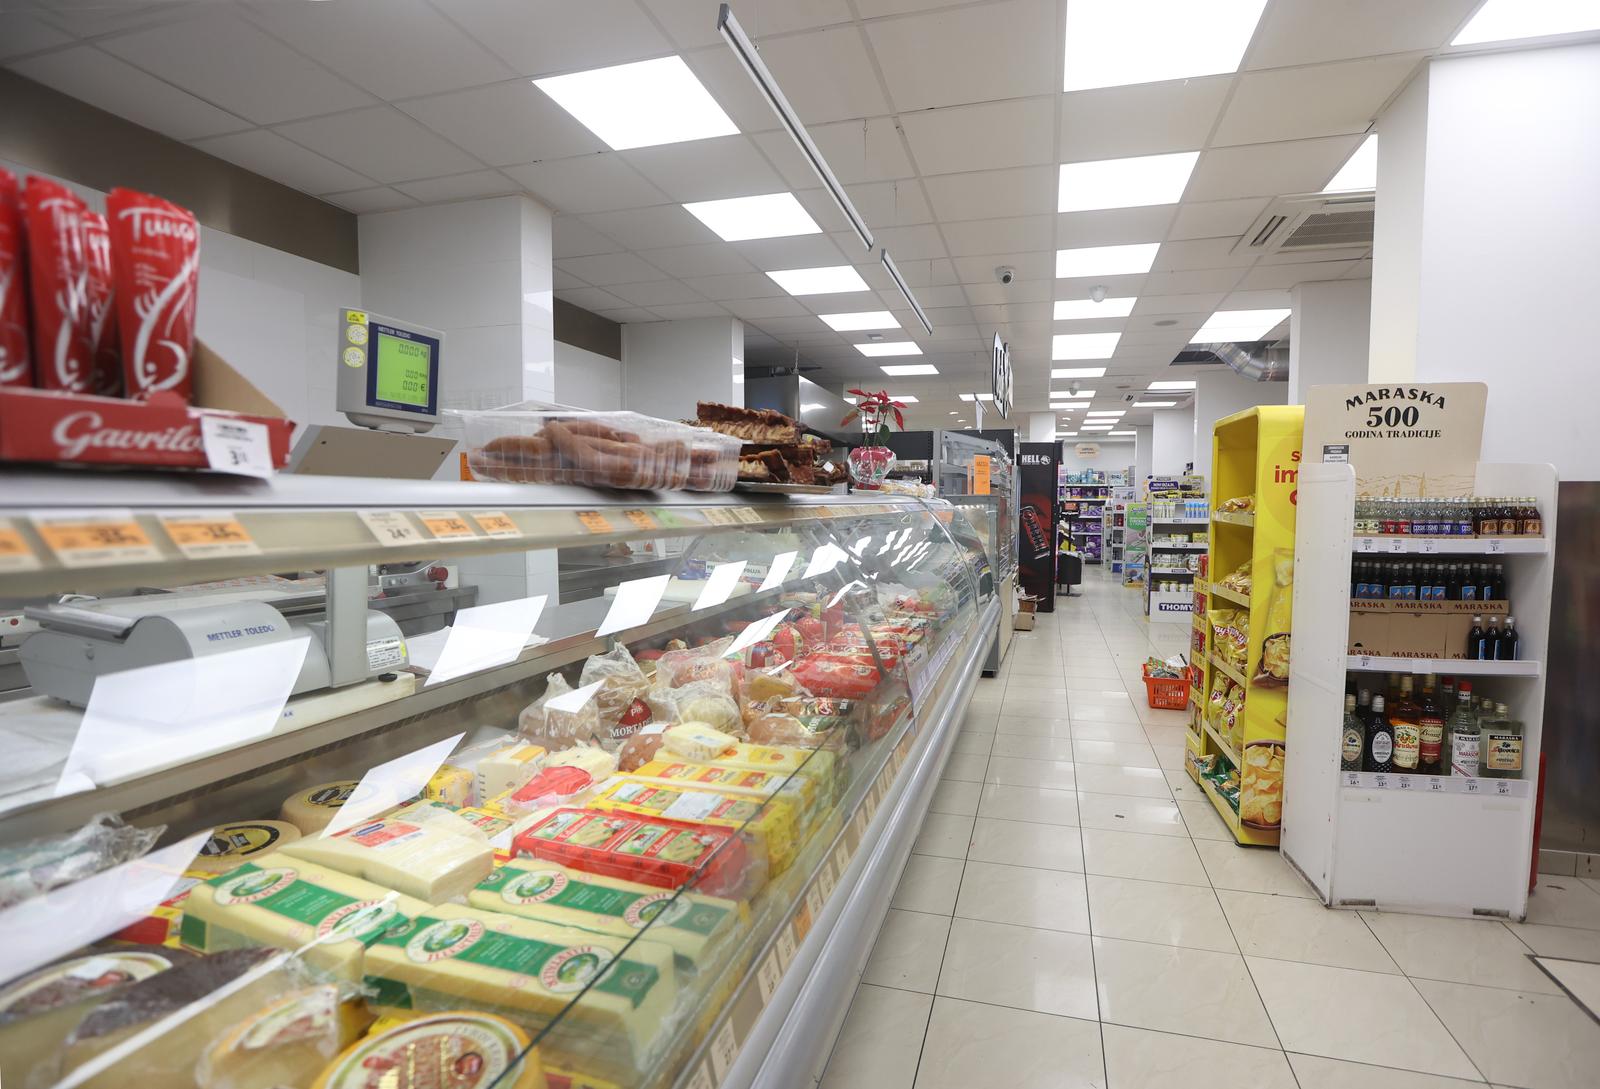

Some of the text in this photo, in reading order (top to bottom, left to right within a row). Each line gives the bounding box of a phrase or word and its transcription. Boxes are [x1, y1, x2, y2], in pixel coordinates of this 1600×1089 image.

[1346, 387, 1446, 411] MARASKA
[1366, 405, 1419, 428] 500
[1345, 429, 1441, 439] GODINA TRADICIJE
[1021, 455, 1040, 463] HELL
[1394, 602, 1442, 610] MARASKA
[207, 625, 275, 641] METTLER TOLEDO
[1391, 651, 1439, 659] MARASKA
[631, 705, 643, 717] pik
